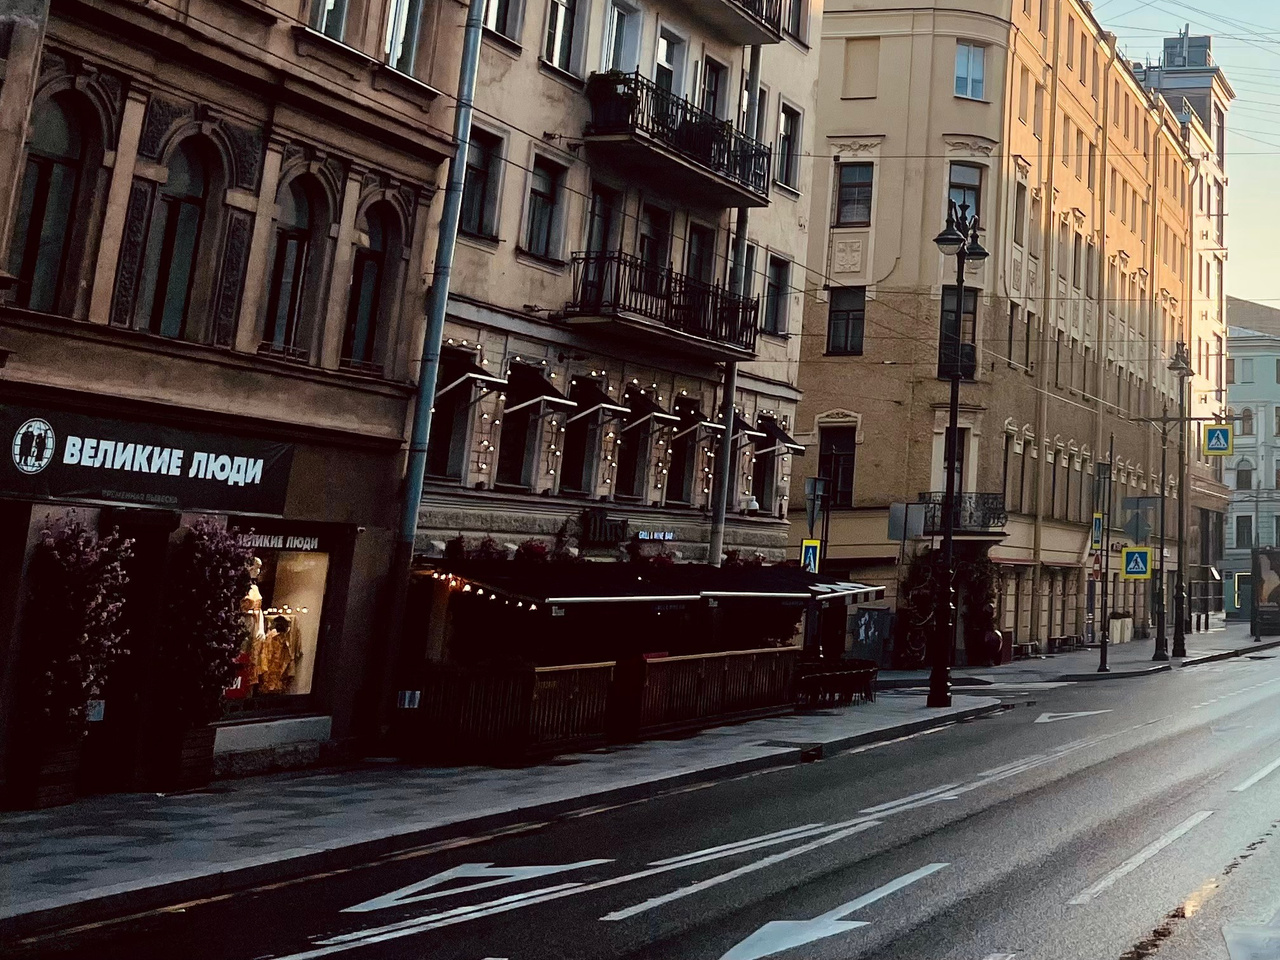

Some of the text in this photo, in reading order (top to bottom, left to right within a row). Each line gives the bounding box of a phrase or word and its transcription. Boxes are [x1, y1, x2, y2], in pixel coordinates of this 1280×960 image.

[63, 435, 264, 487] ВЕЛИКИЕ ЛЮДИ
[286, 536, 319, 551] ЛЮДИ
